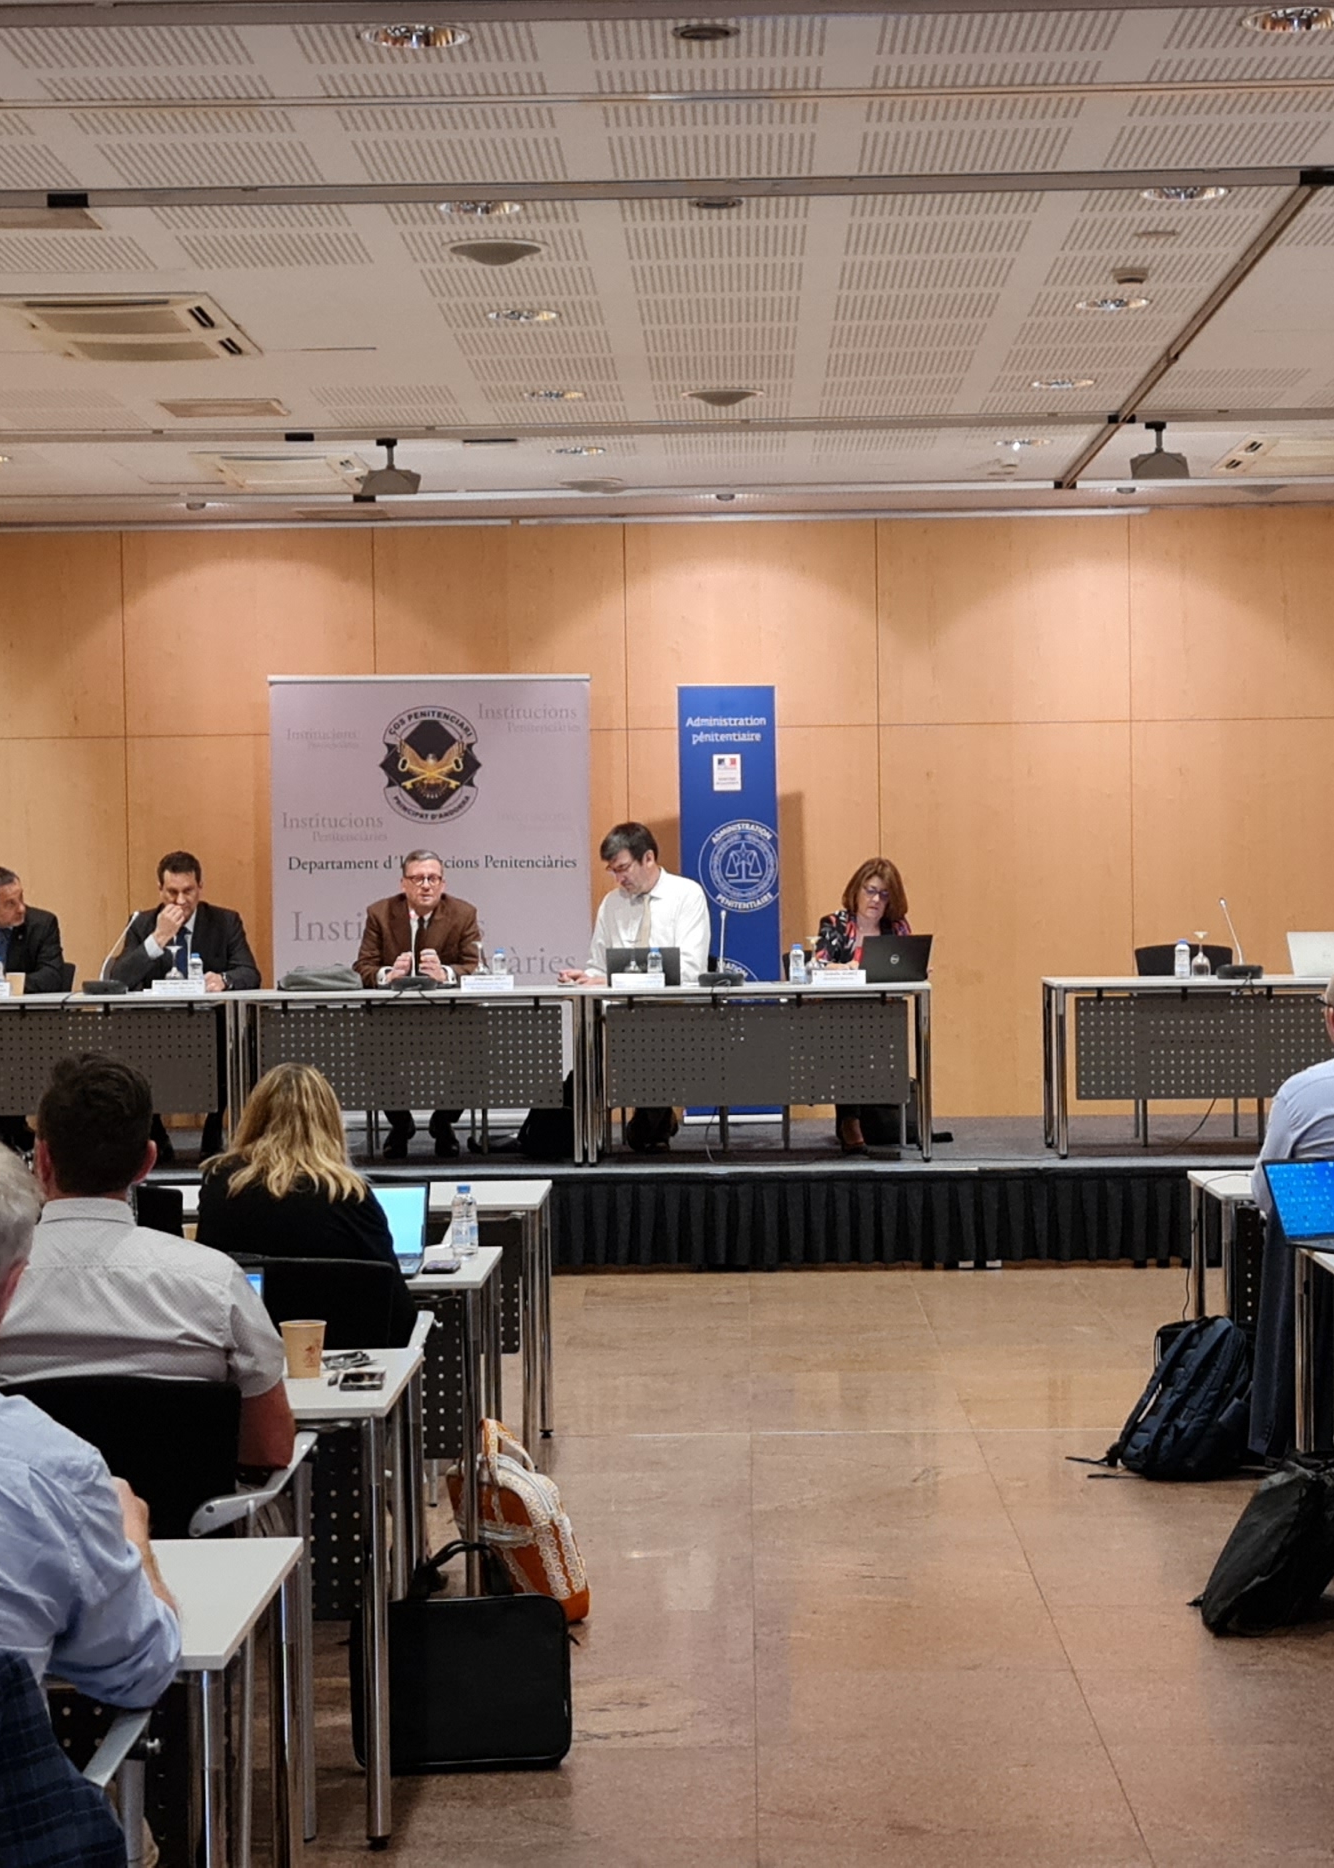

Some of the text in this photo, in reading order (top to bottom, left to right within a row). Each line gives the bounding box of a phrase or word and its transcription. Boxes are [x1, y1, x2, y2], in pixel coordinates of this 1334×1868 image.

[478, 703, 578, 720] Institucions
[388, 718, 406, 736] COS
[685, 715, 767, 728] Administration
[691, 730, 762, 745] pénitentiaire
[282, 811, 384, 829] Institucions
[288, 856, 379, 872] Departament
[484, 854, 578, 870] Penitenciàries
